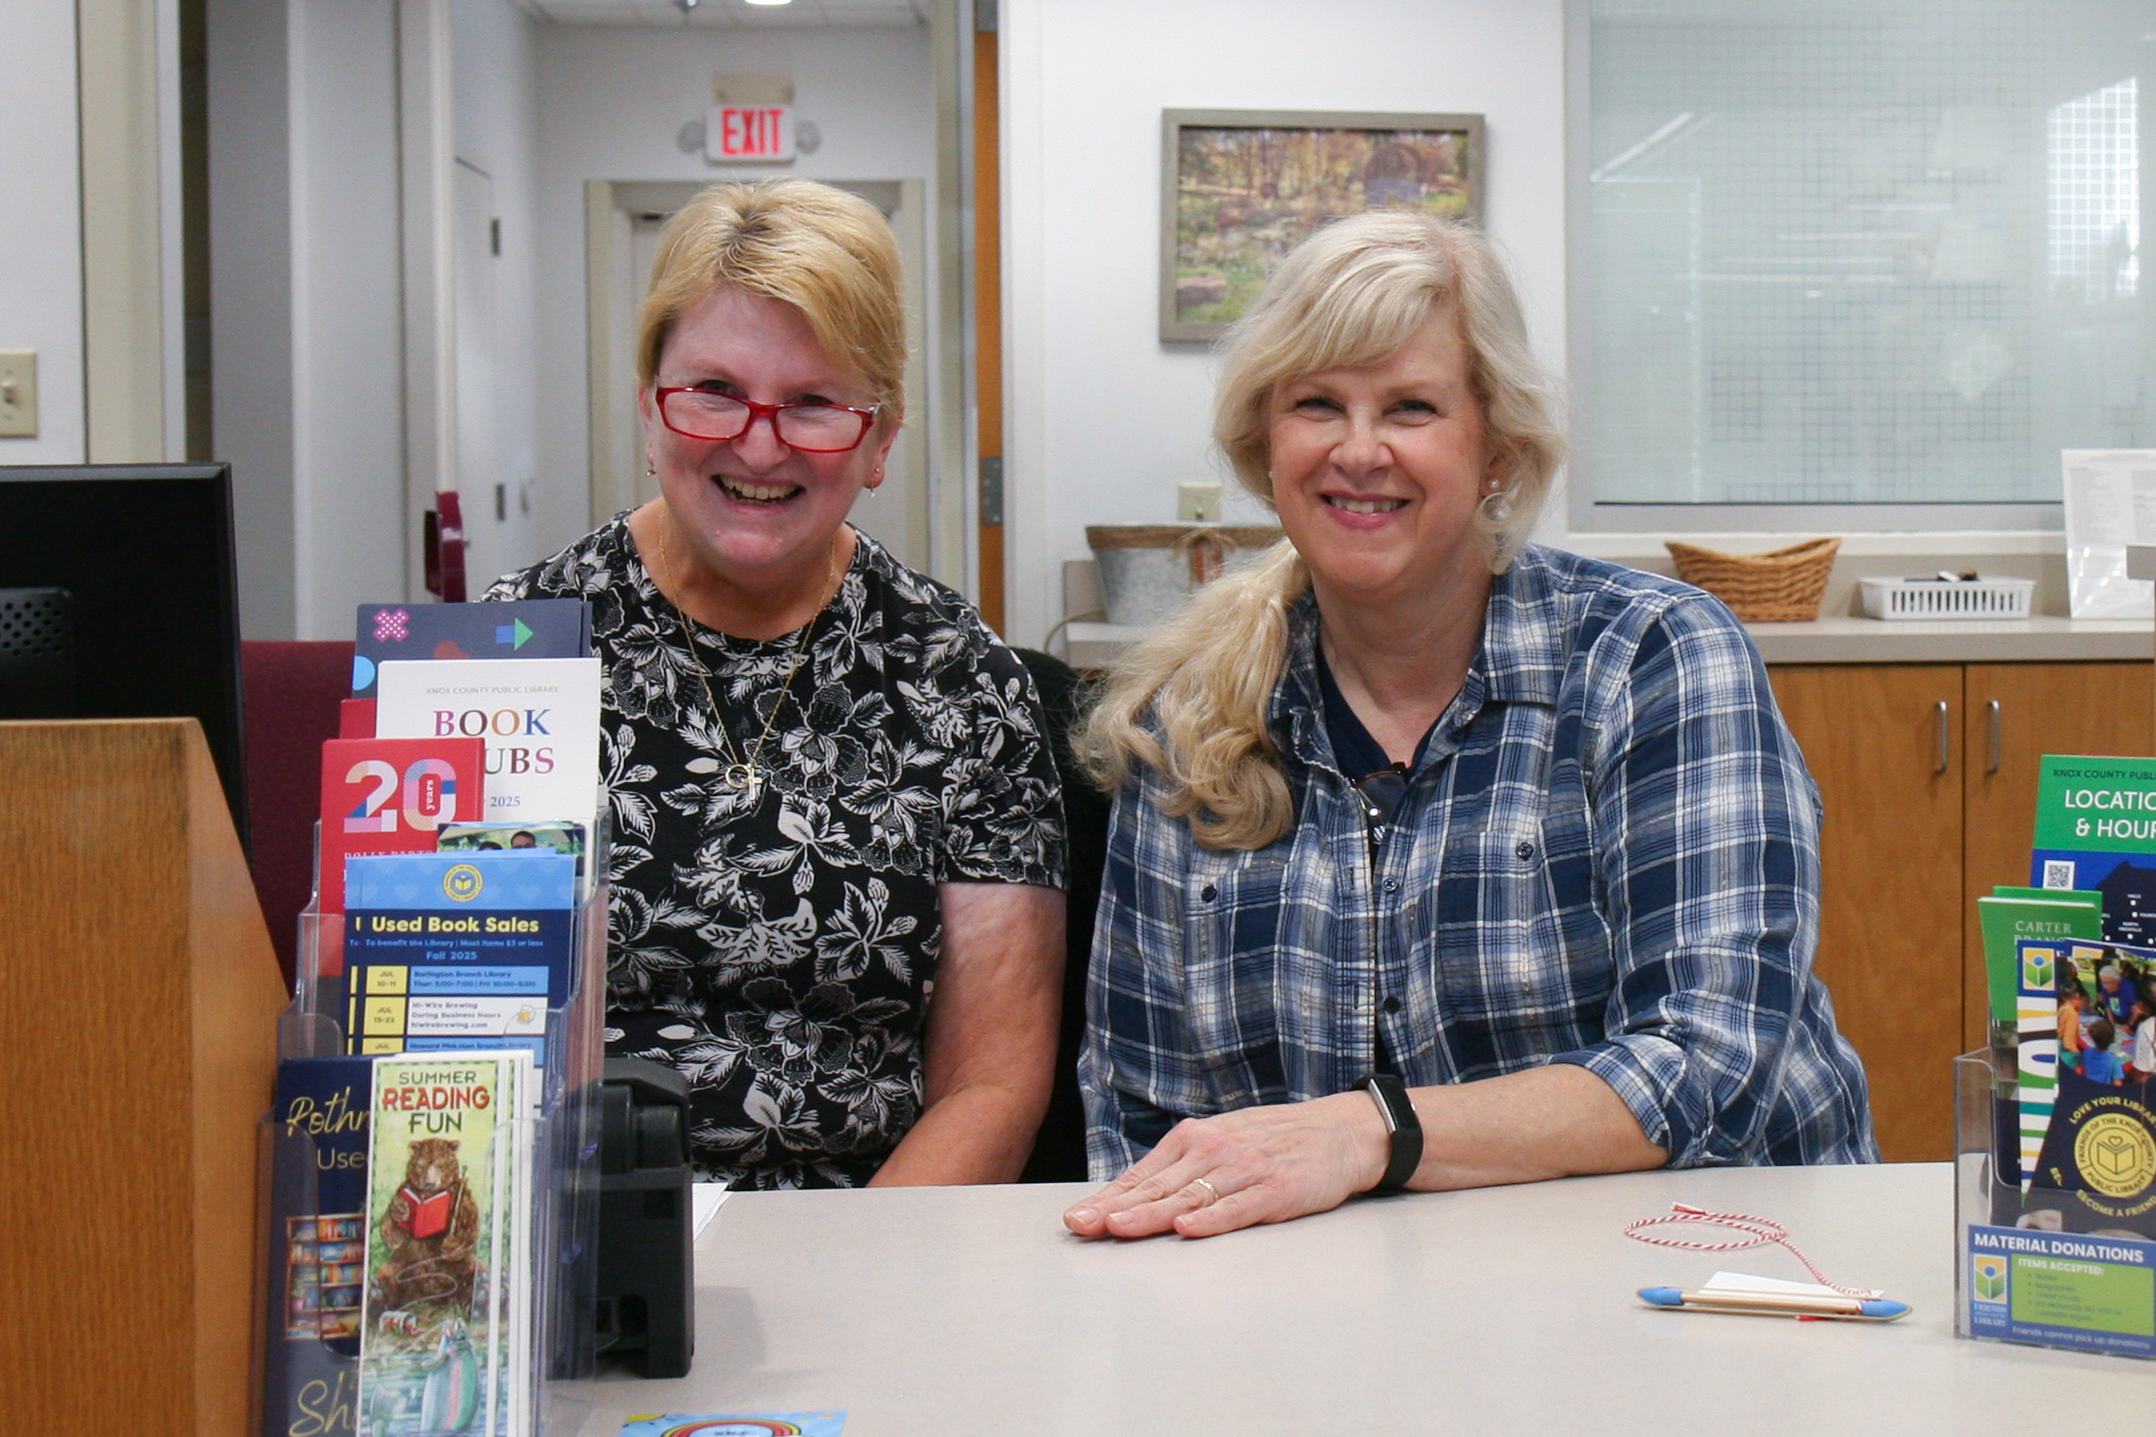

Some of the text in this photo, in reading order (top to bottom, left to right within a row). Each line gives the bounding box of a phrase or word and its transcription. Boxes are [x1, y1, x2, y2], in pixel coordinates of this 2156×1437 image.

[721, 108, 785, 155] EXIT
[453, 686, 489, 694] COUNTY
[491, 686, 522, 694] PUBLIC
[524, 685, 559, 693] LIBRARY
[433, 708, 551, 736] BOOK
[485, 746, 555, 775] UBS
[2053, 769, 2081, 778] KNOX
[2084, 770, 2126, 779] COUNTY
[344, 758, 457, 833] 20
[426, 779, 436, 811] years
[490, 796, 521, 808] 2025
[2076, 817, 2091, 837] &
[372, 916, 539, 933] Used Book Sales
[2015, 920, 2072, 934] CARTER
[425, 939, 455, 948] Library
[426, 951, 477, 960] Fall 2025
[398, 1070, 477, 1085] SUMMER
[382, 1085, 490, 1111] READING
[2069, 1102, 2092, 1124] LOVE
[2091, 1096, 2121, 1107] YOUR
[2102, 1117, 2117, 1125] THE
[409, 1112, 462, 1134] FUN
[317, 1148, 367, 1170] Use
[2076, 1189, 2114, 1216] BECOME
[2116, 1208, 2124, 1217] A
[1974, 1232, 2144, 1263] MATERIAL DONATIONS
[2018, 1257, 2105, 1276] ITEMS ACCEPTED:
[289, 1371, 358, 1437] Sh
